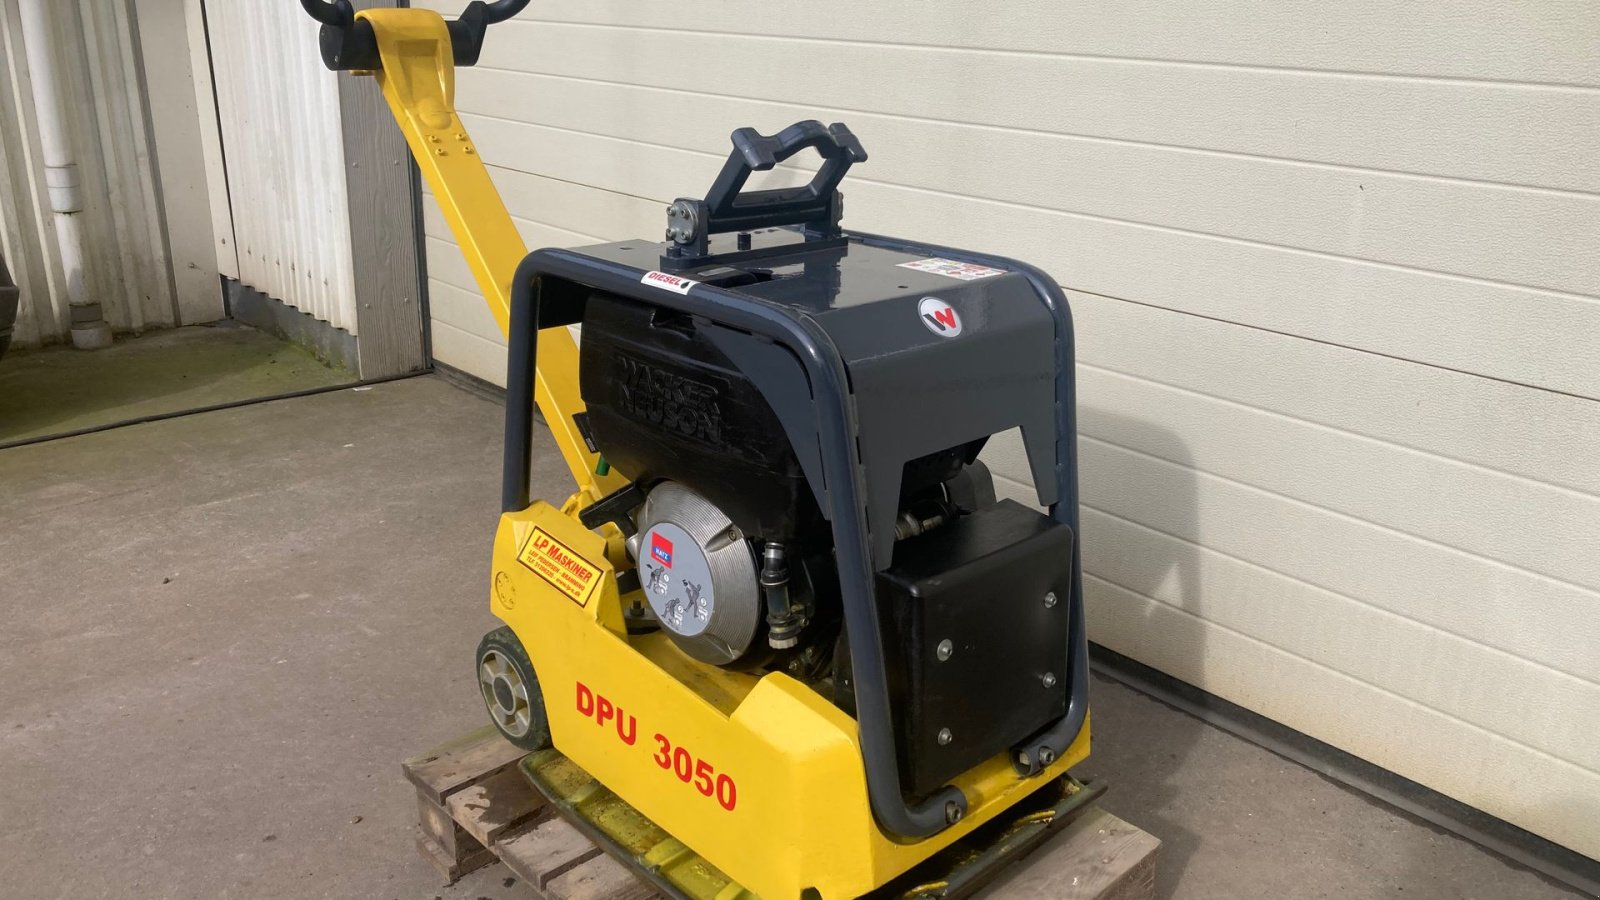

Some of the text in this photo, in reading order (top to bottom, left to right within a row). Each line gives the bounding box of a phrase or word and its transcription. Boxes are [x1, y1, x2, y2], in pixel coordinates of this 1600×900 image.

[648, 272, 682, 286] DIESEL
[617, 356, 720, 412] WACKER
[618, 380, 722, 441] NEUSON
[533, 535, 593, 583] LP MASKINER
[576, 681, 637, 746] DPU
[653, 733, 737, 811] 3050
